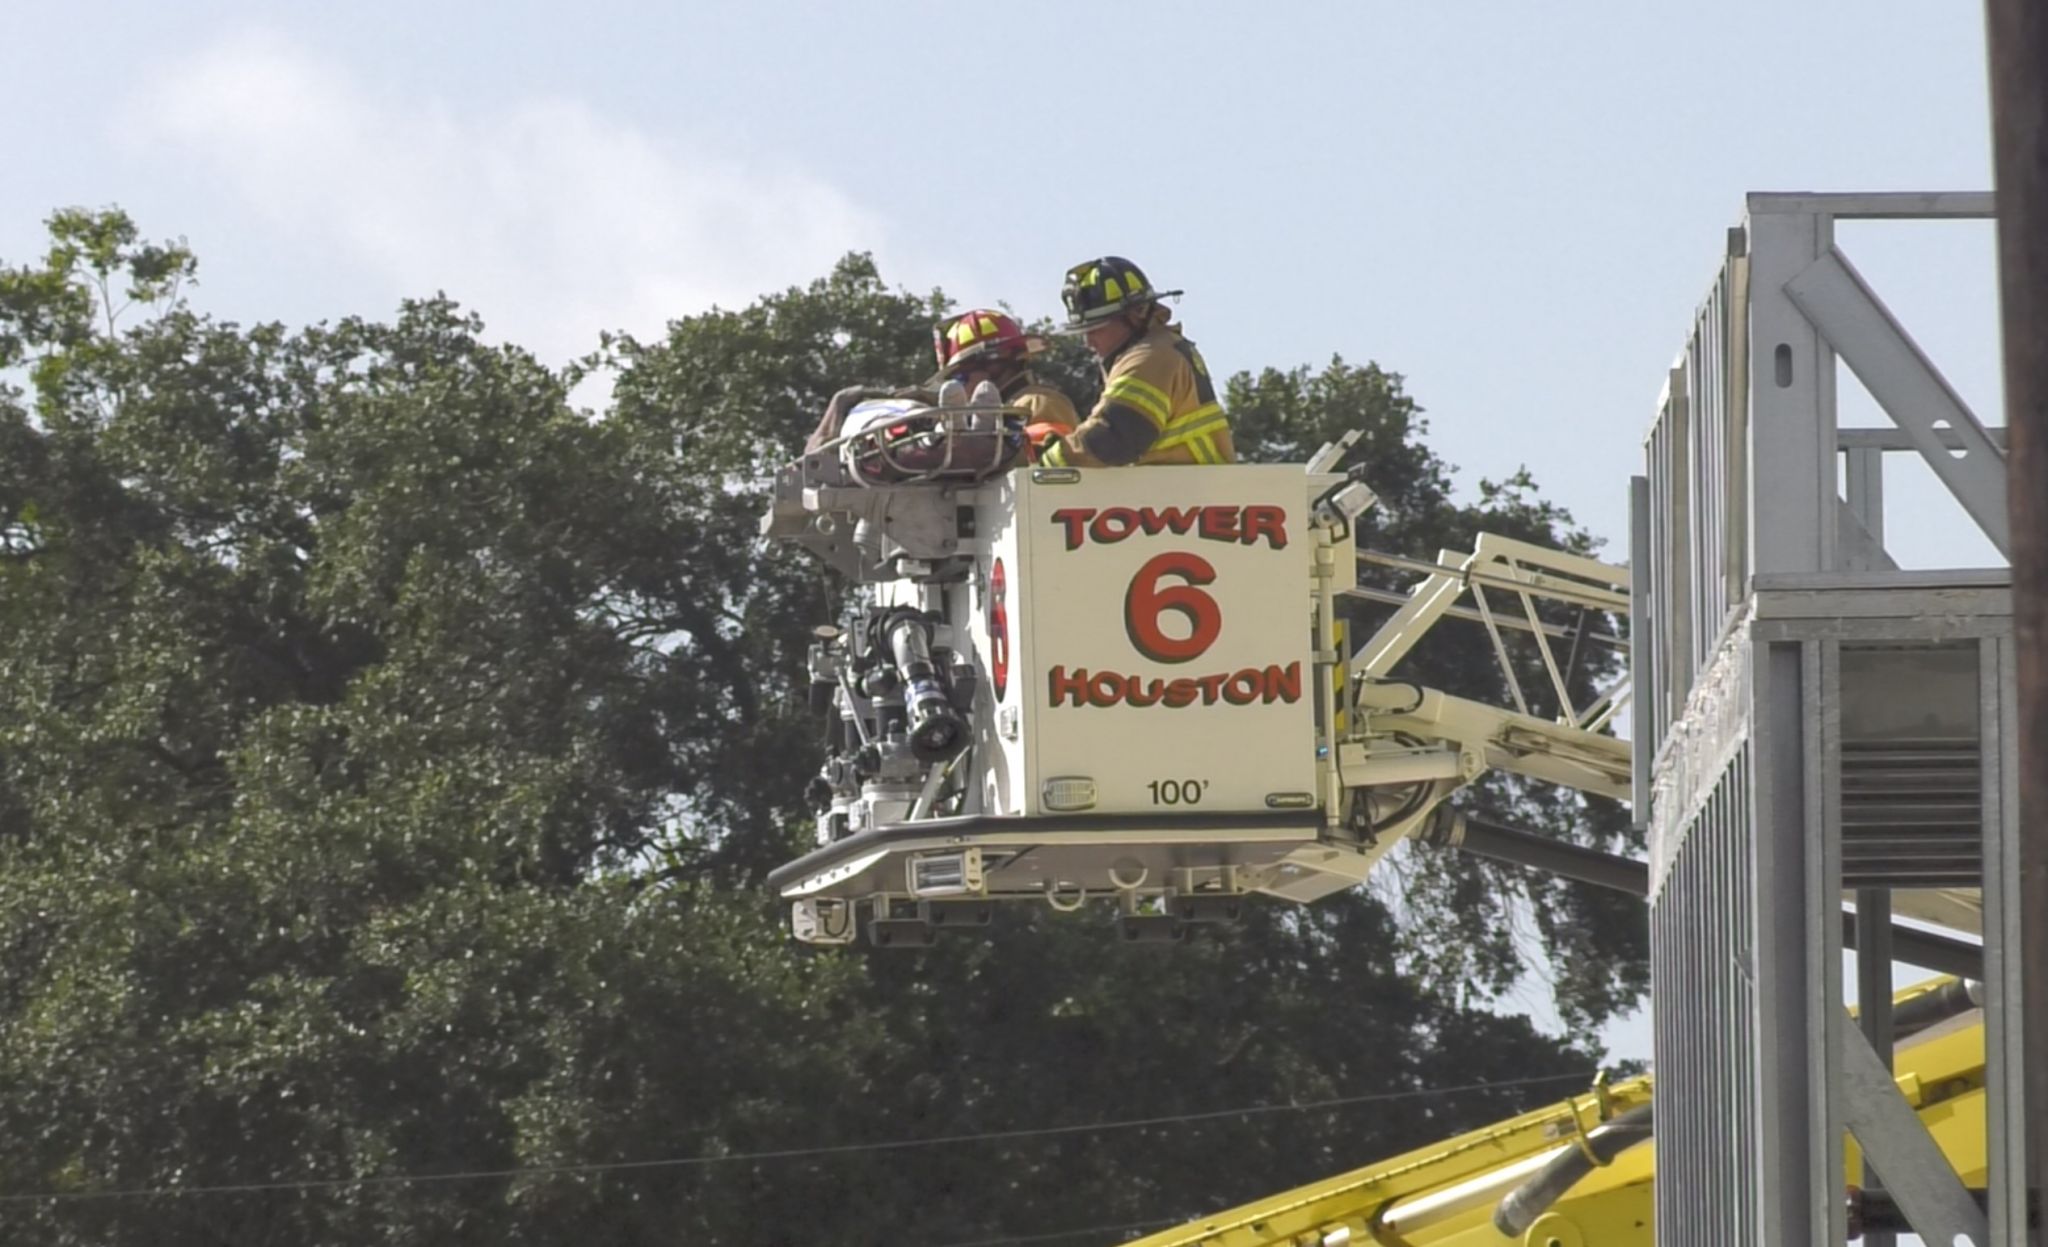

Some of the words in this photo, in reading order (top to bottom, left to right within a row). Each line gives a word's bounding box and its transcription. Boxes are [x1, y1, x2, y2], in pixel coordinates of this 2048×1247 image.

[1051, 505, 1288, 551] TOWER
[1124, 551, 1221, 664] 6
[1048, 660, 1302, 708] HOUSTON
